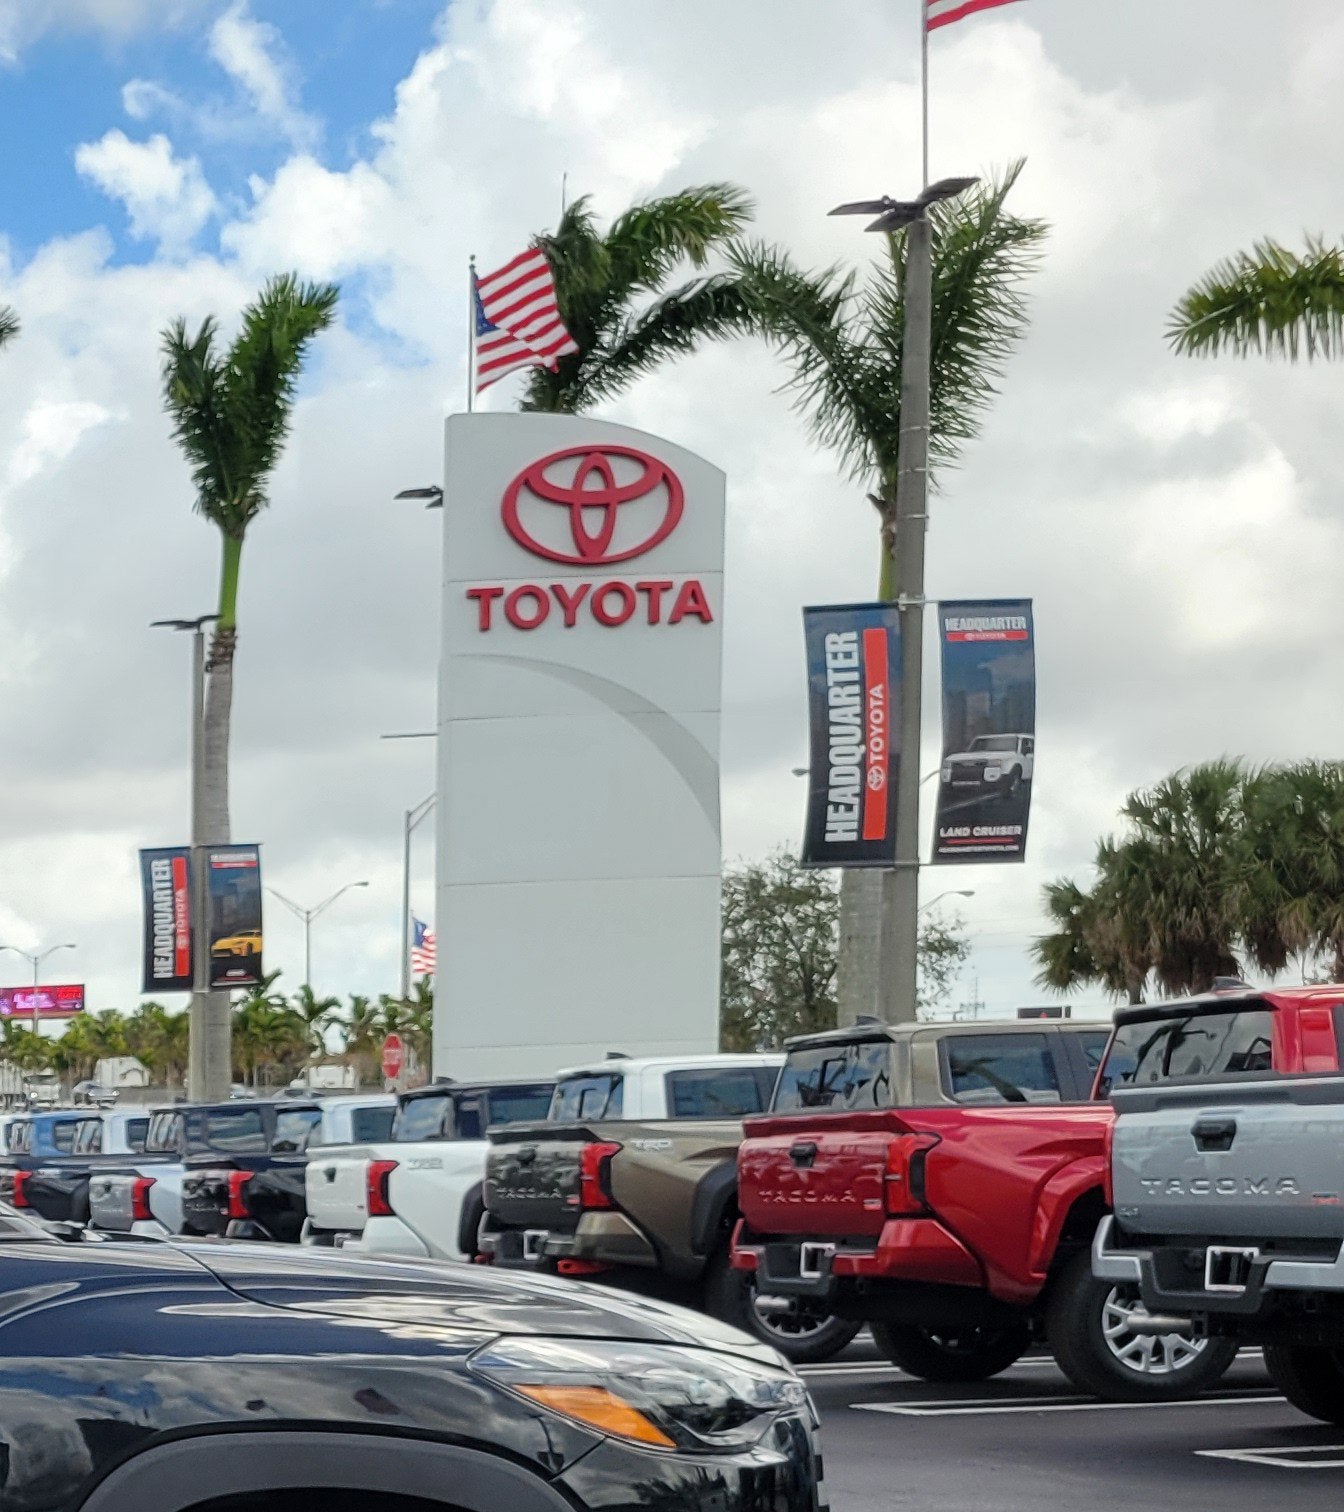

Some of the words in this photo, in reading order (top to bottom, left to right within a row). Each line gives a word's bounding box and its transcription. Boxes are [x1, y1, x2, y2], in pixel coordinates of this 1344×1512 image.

[466, 580, 714, 632] TOYOTA
[944, 616, 1026, 632] HEADQUARTER
[824, 631, 866, 843] HEADQUARTER
[869, 683, 885, 764] TOYOTA
[939, 827, 971, 838] LAND
[972, 825, 1023, 837] CRUISER
[151, 859, 176, 979] HEADQUARTER
[758, 1189, 856, 1203] TACOMA
[1140, 1178, 1300, 1195] TACOMA
